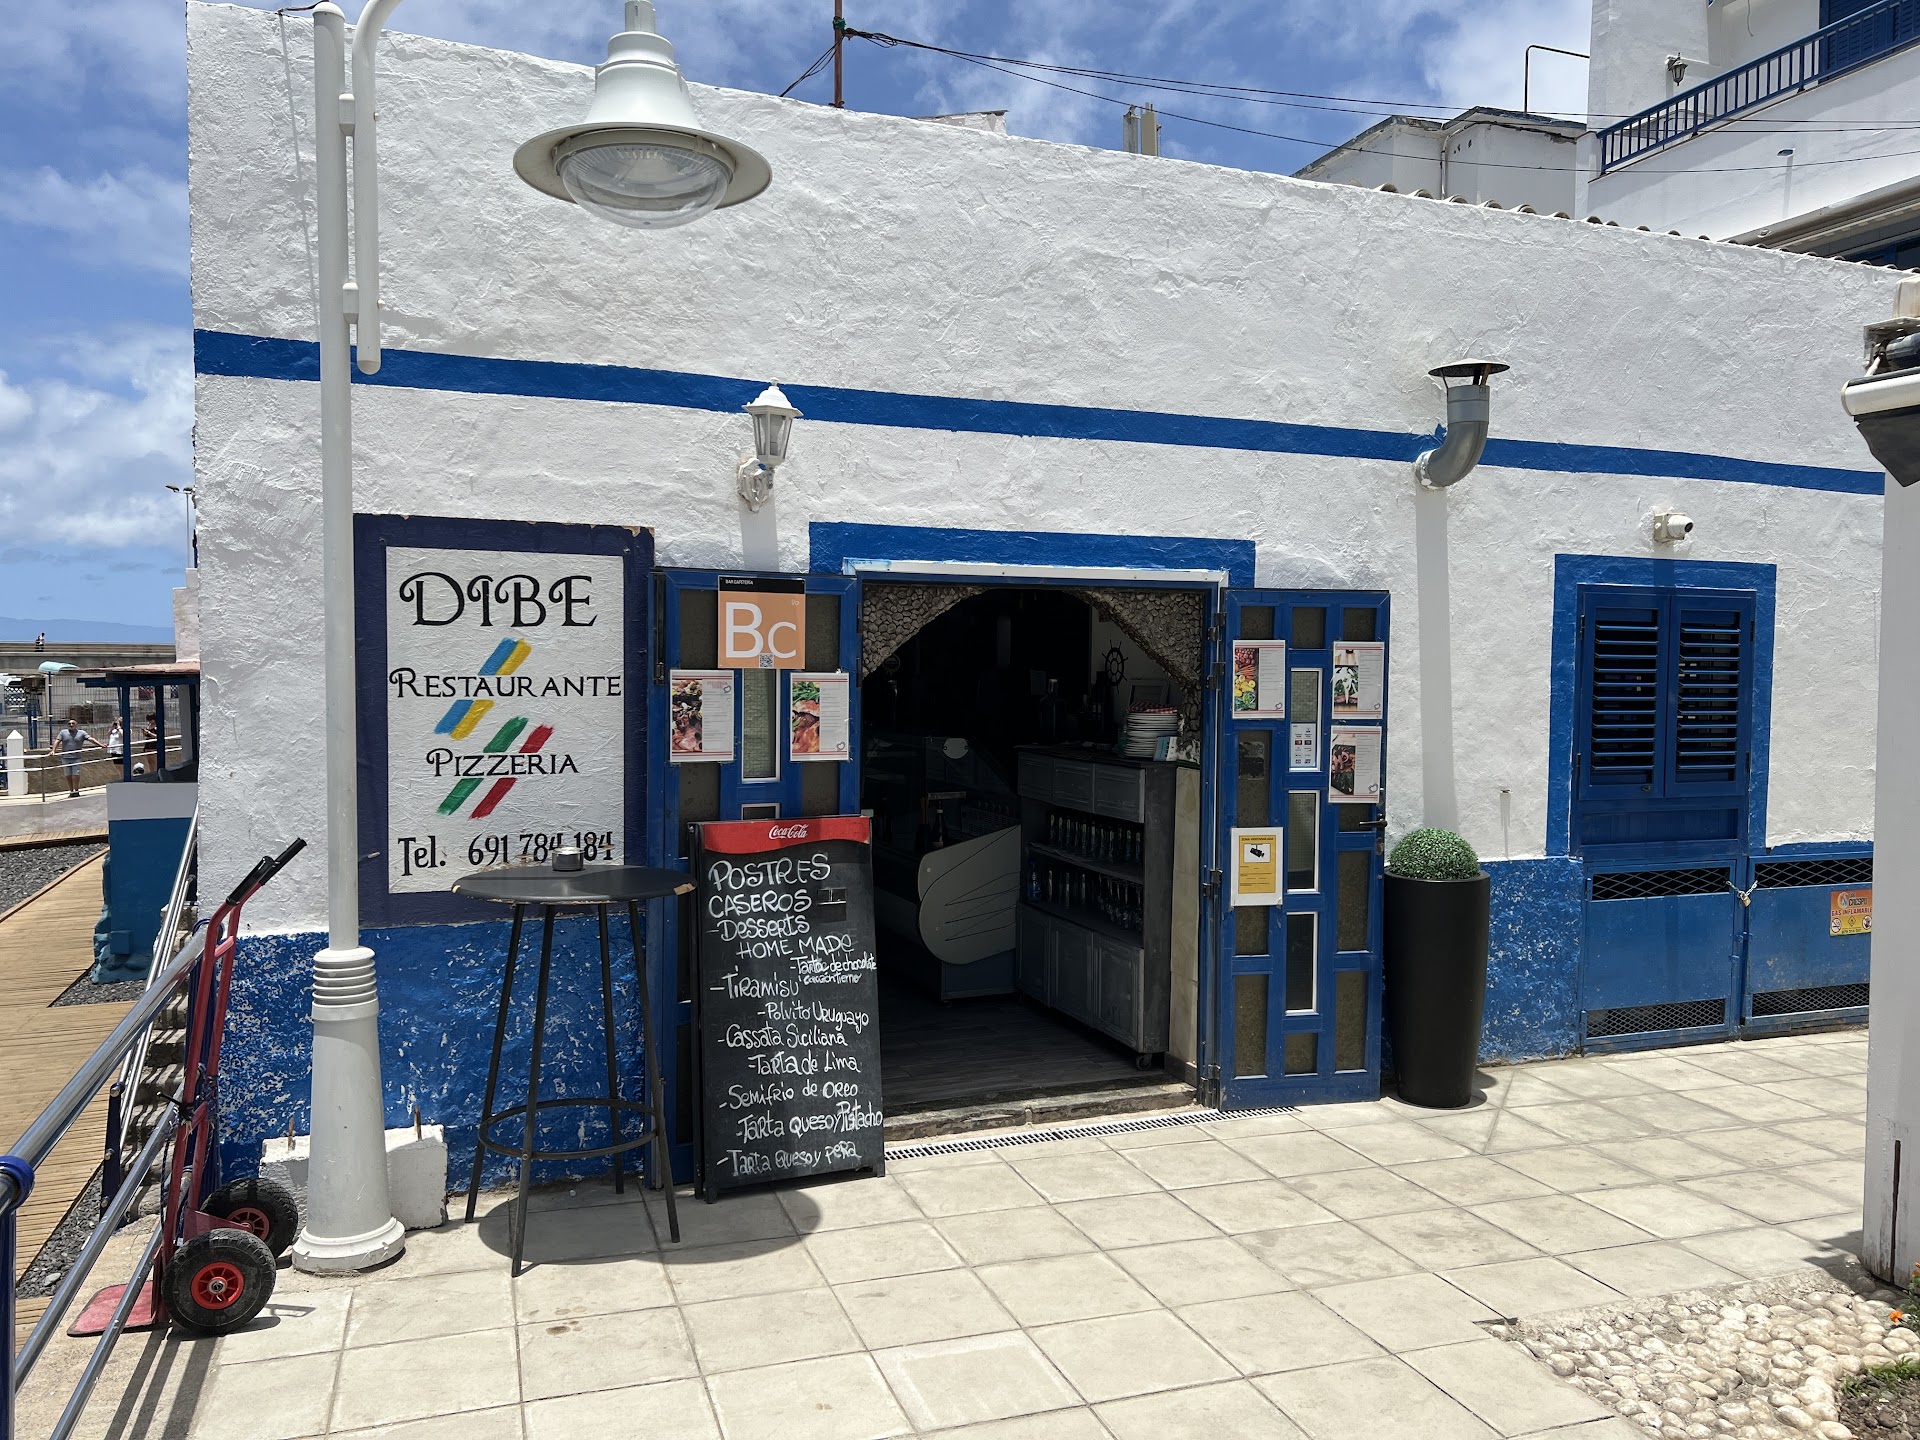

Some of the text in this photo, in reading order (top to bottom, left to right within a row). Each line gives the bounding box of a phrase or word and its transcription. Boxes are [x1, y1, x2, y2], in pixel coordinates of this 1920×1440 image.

[399, 572, 598, 627] DIBE
[725, 601, 798, 659] Bc
[768, 824, 810, 840] Coca-Cola
[398, 831, 613, 877] Tel. 691 784 184
[708, 853, 831, 891] POSTRES
[708, 889, 812, 918] CASEROS
[736, 939, 794, 960] HOME
[786, 1023, 848, 1048] Siciliana
[801, 1050, 818, 1075] de
[824, 1050, 862, 1073] Lima
[802, 1079, 818, 1096] de
